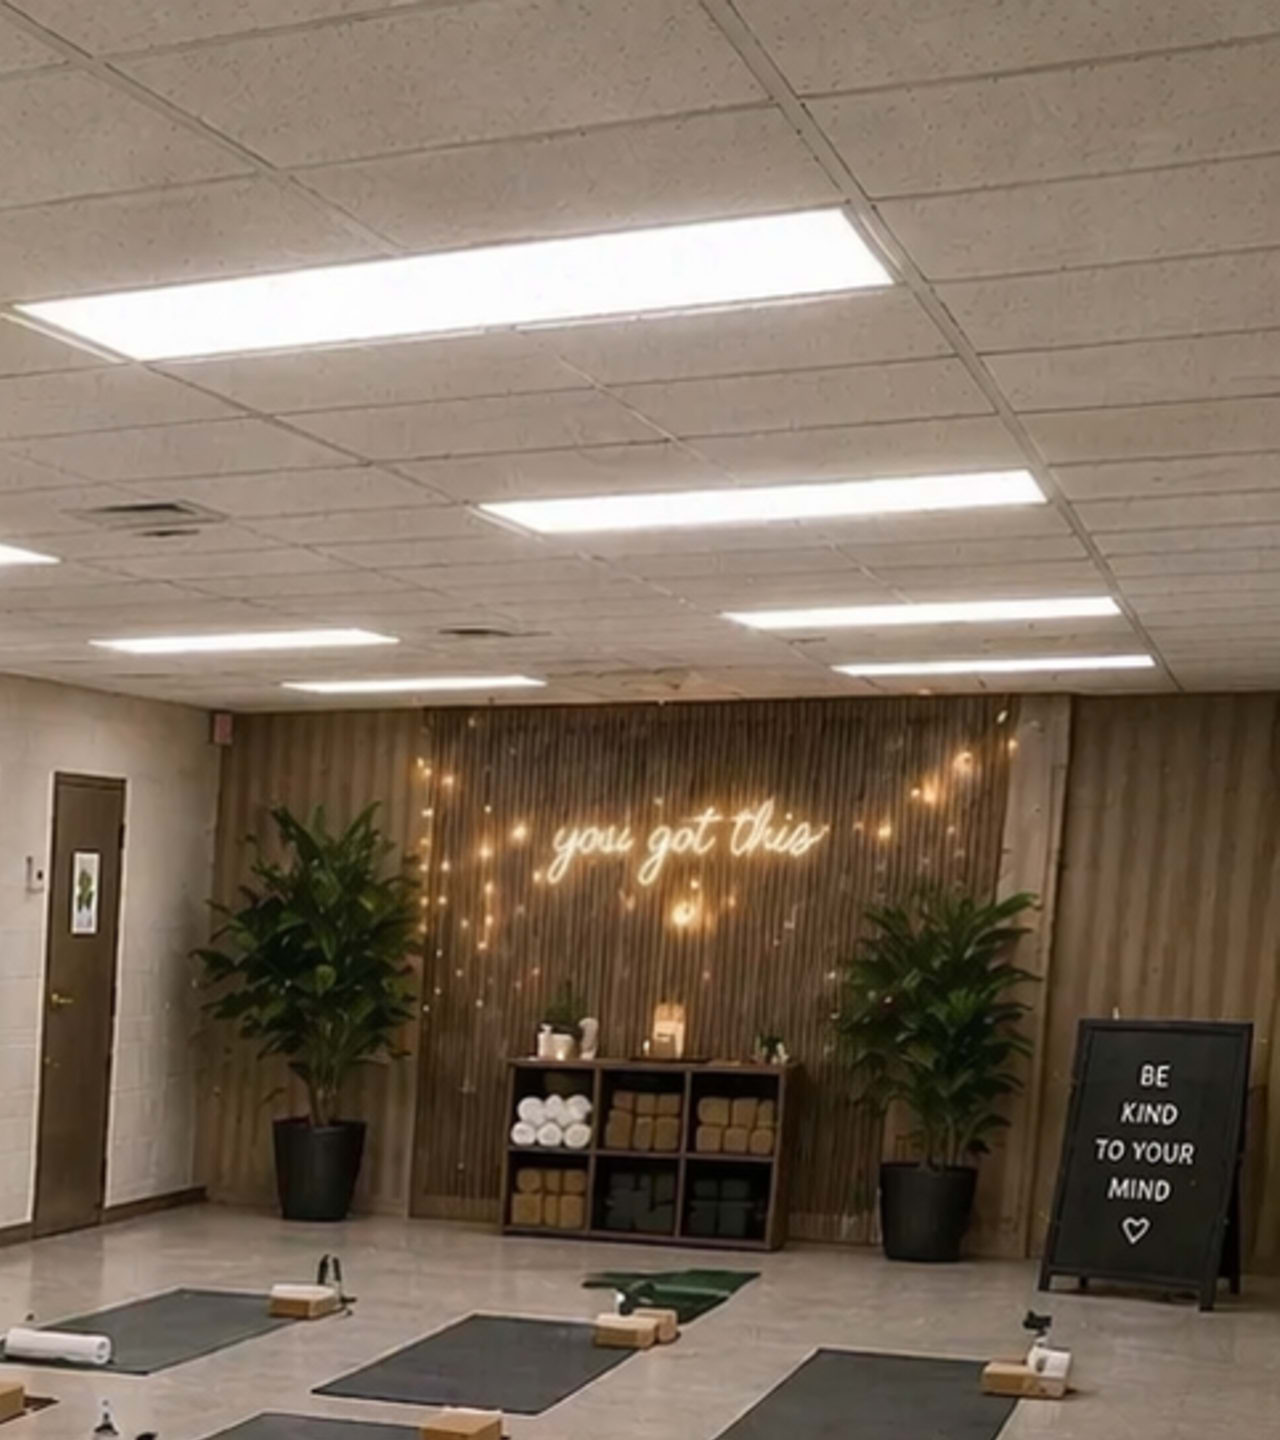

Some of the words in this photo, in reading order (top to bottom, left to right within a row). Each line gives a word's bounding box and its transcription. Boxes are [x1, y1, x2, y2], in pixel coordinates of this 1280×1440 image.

[547, 824, 634, 885] you
[638, 806, 724, 886] got
[730, 796, 830, 857] this
[1140, 1064, 1170, 1088] BE
[1120, 1102, 1178, 1126] KIND
[1095, 1138, 1125, 1161] TO
[1132, 1141, 1195, 1165] YOUR
[1107, 1177, 1171, 1202] MIND
